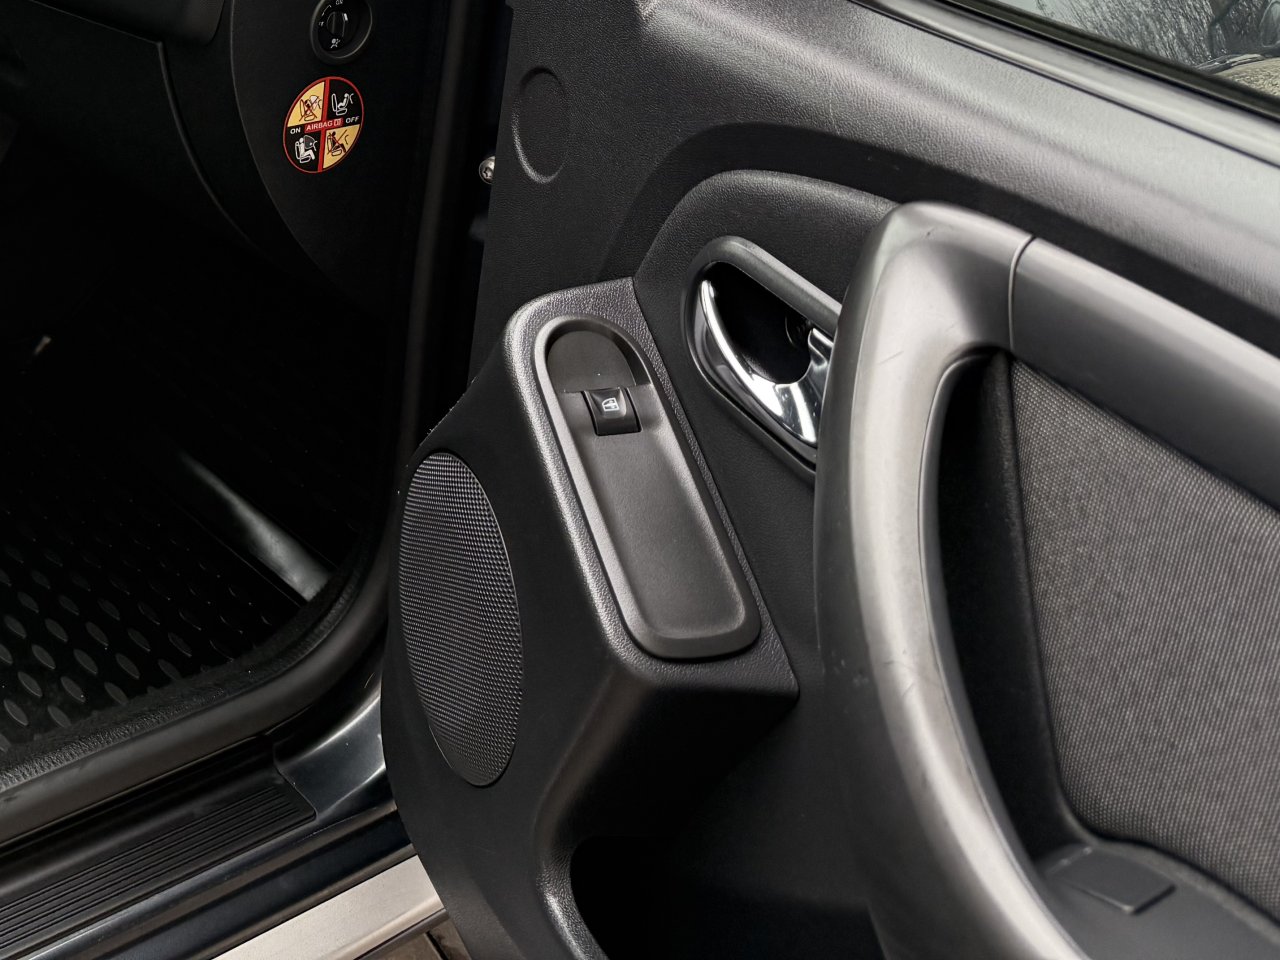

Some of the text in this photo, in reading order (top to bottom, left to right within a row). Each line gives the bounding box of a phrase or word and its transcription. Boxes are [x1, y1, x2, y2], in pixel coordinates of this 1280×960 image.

[290, 116, 359, 134] ON AIRBAG OFF
